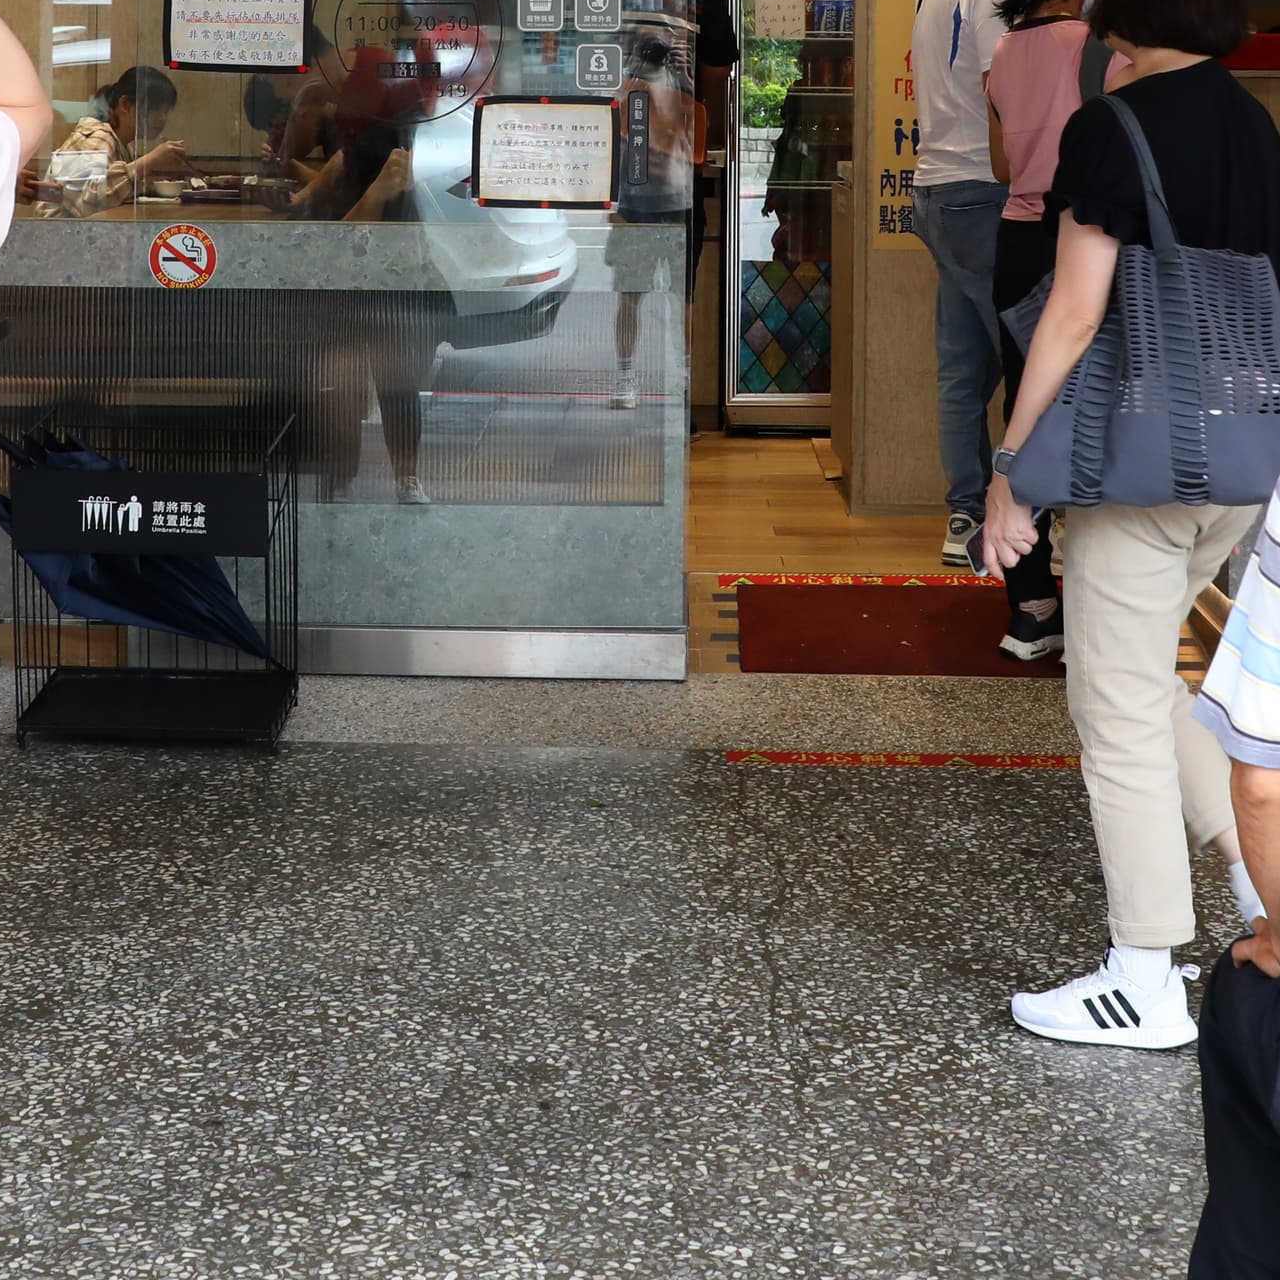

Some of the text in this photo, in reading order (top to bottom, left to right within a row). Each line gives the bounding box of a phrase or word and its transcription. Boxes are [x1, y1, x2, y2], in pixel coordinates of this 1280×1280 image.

[188, 29, 287, 41] 非常感謝您的配合
[169, 272, 210, 288] SMOKING
[152, 501, 207, 514] 請將雨傘
[152, 515, 207, 528] 放置此處
[772, 576, 884, 586] 小心斜坡
[792, 752, 922, 765] 小心斜坡
